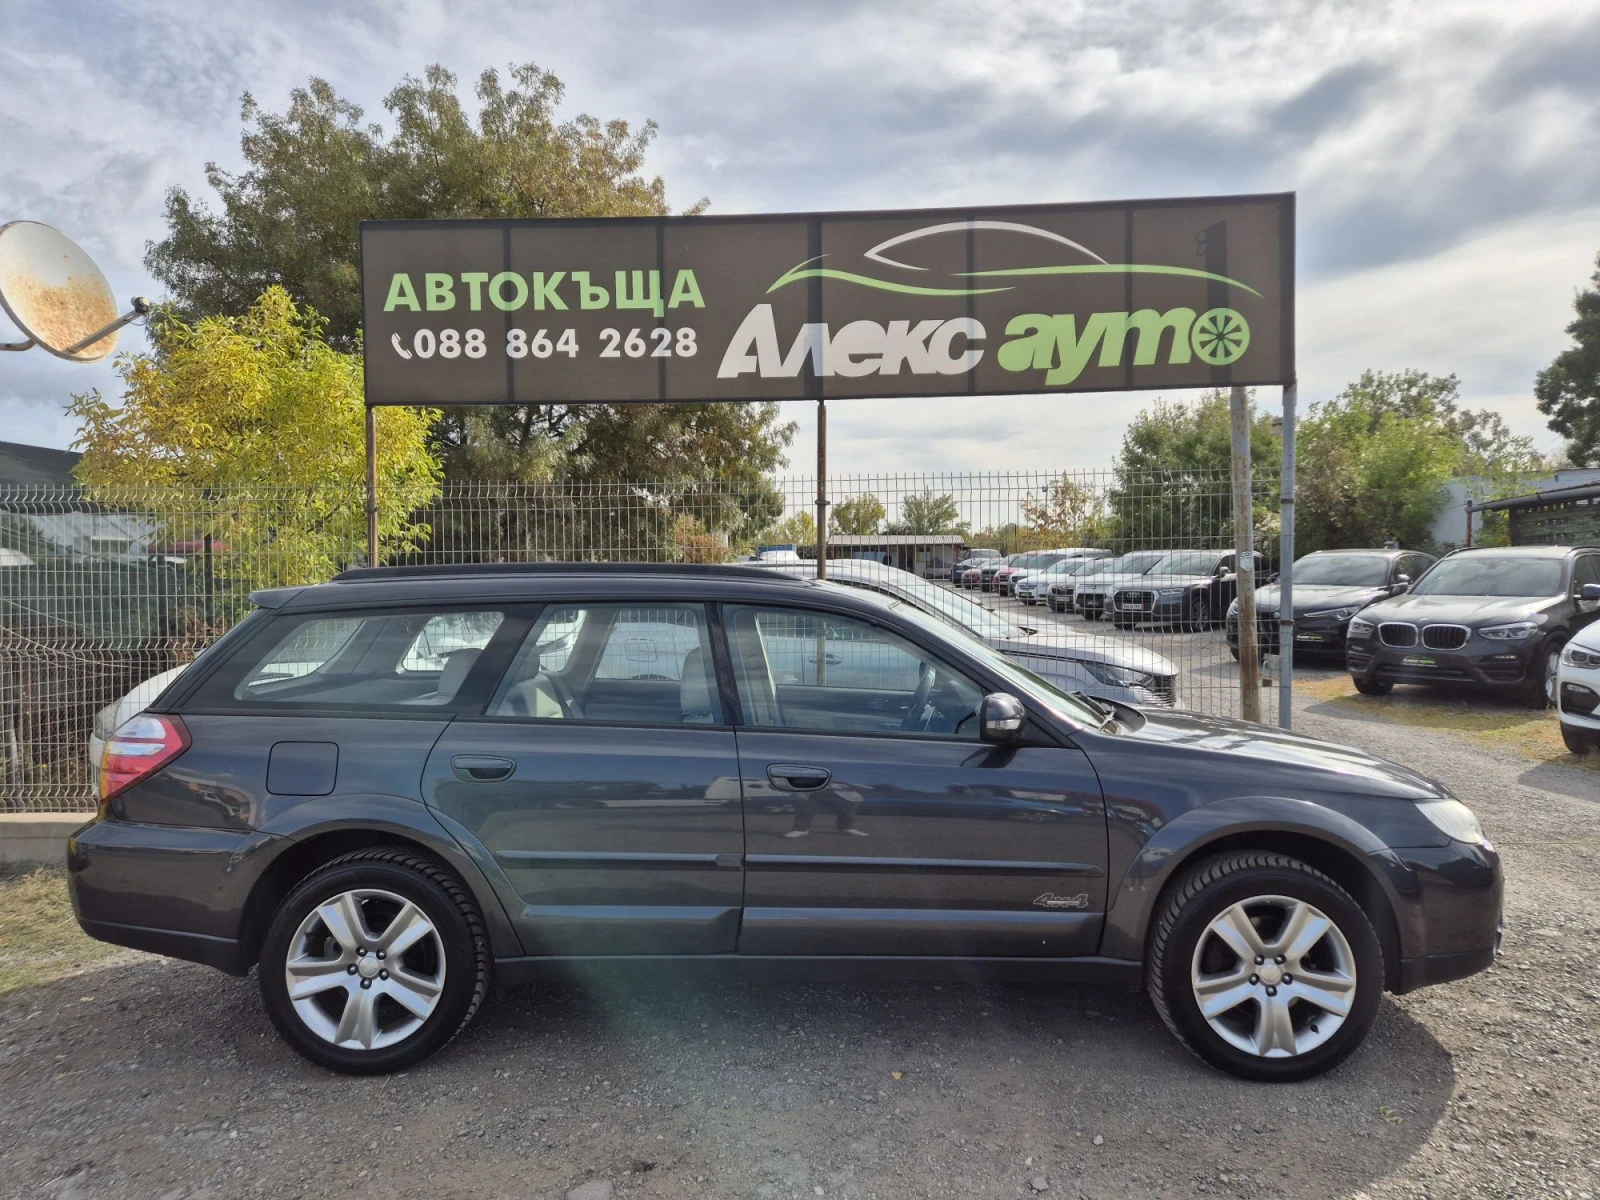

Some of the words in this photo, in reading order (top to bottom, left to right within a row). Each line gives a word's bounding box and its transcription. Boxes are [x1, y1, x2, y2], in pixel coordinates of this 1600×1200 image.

[384, 269, 706, 317] АВТОКЪЩА
[413, 328, 487, 358] 088
[506, 328, 579, 358] 864
[599, 327, 698, 358] 2628
[717, 304, 986, 379] Алекс
